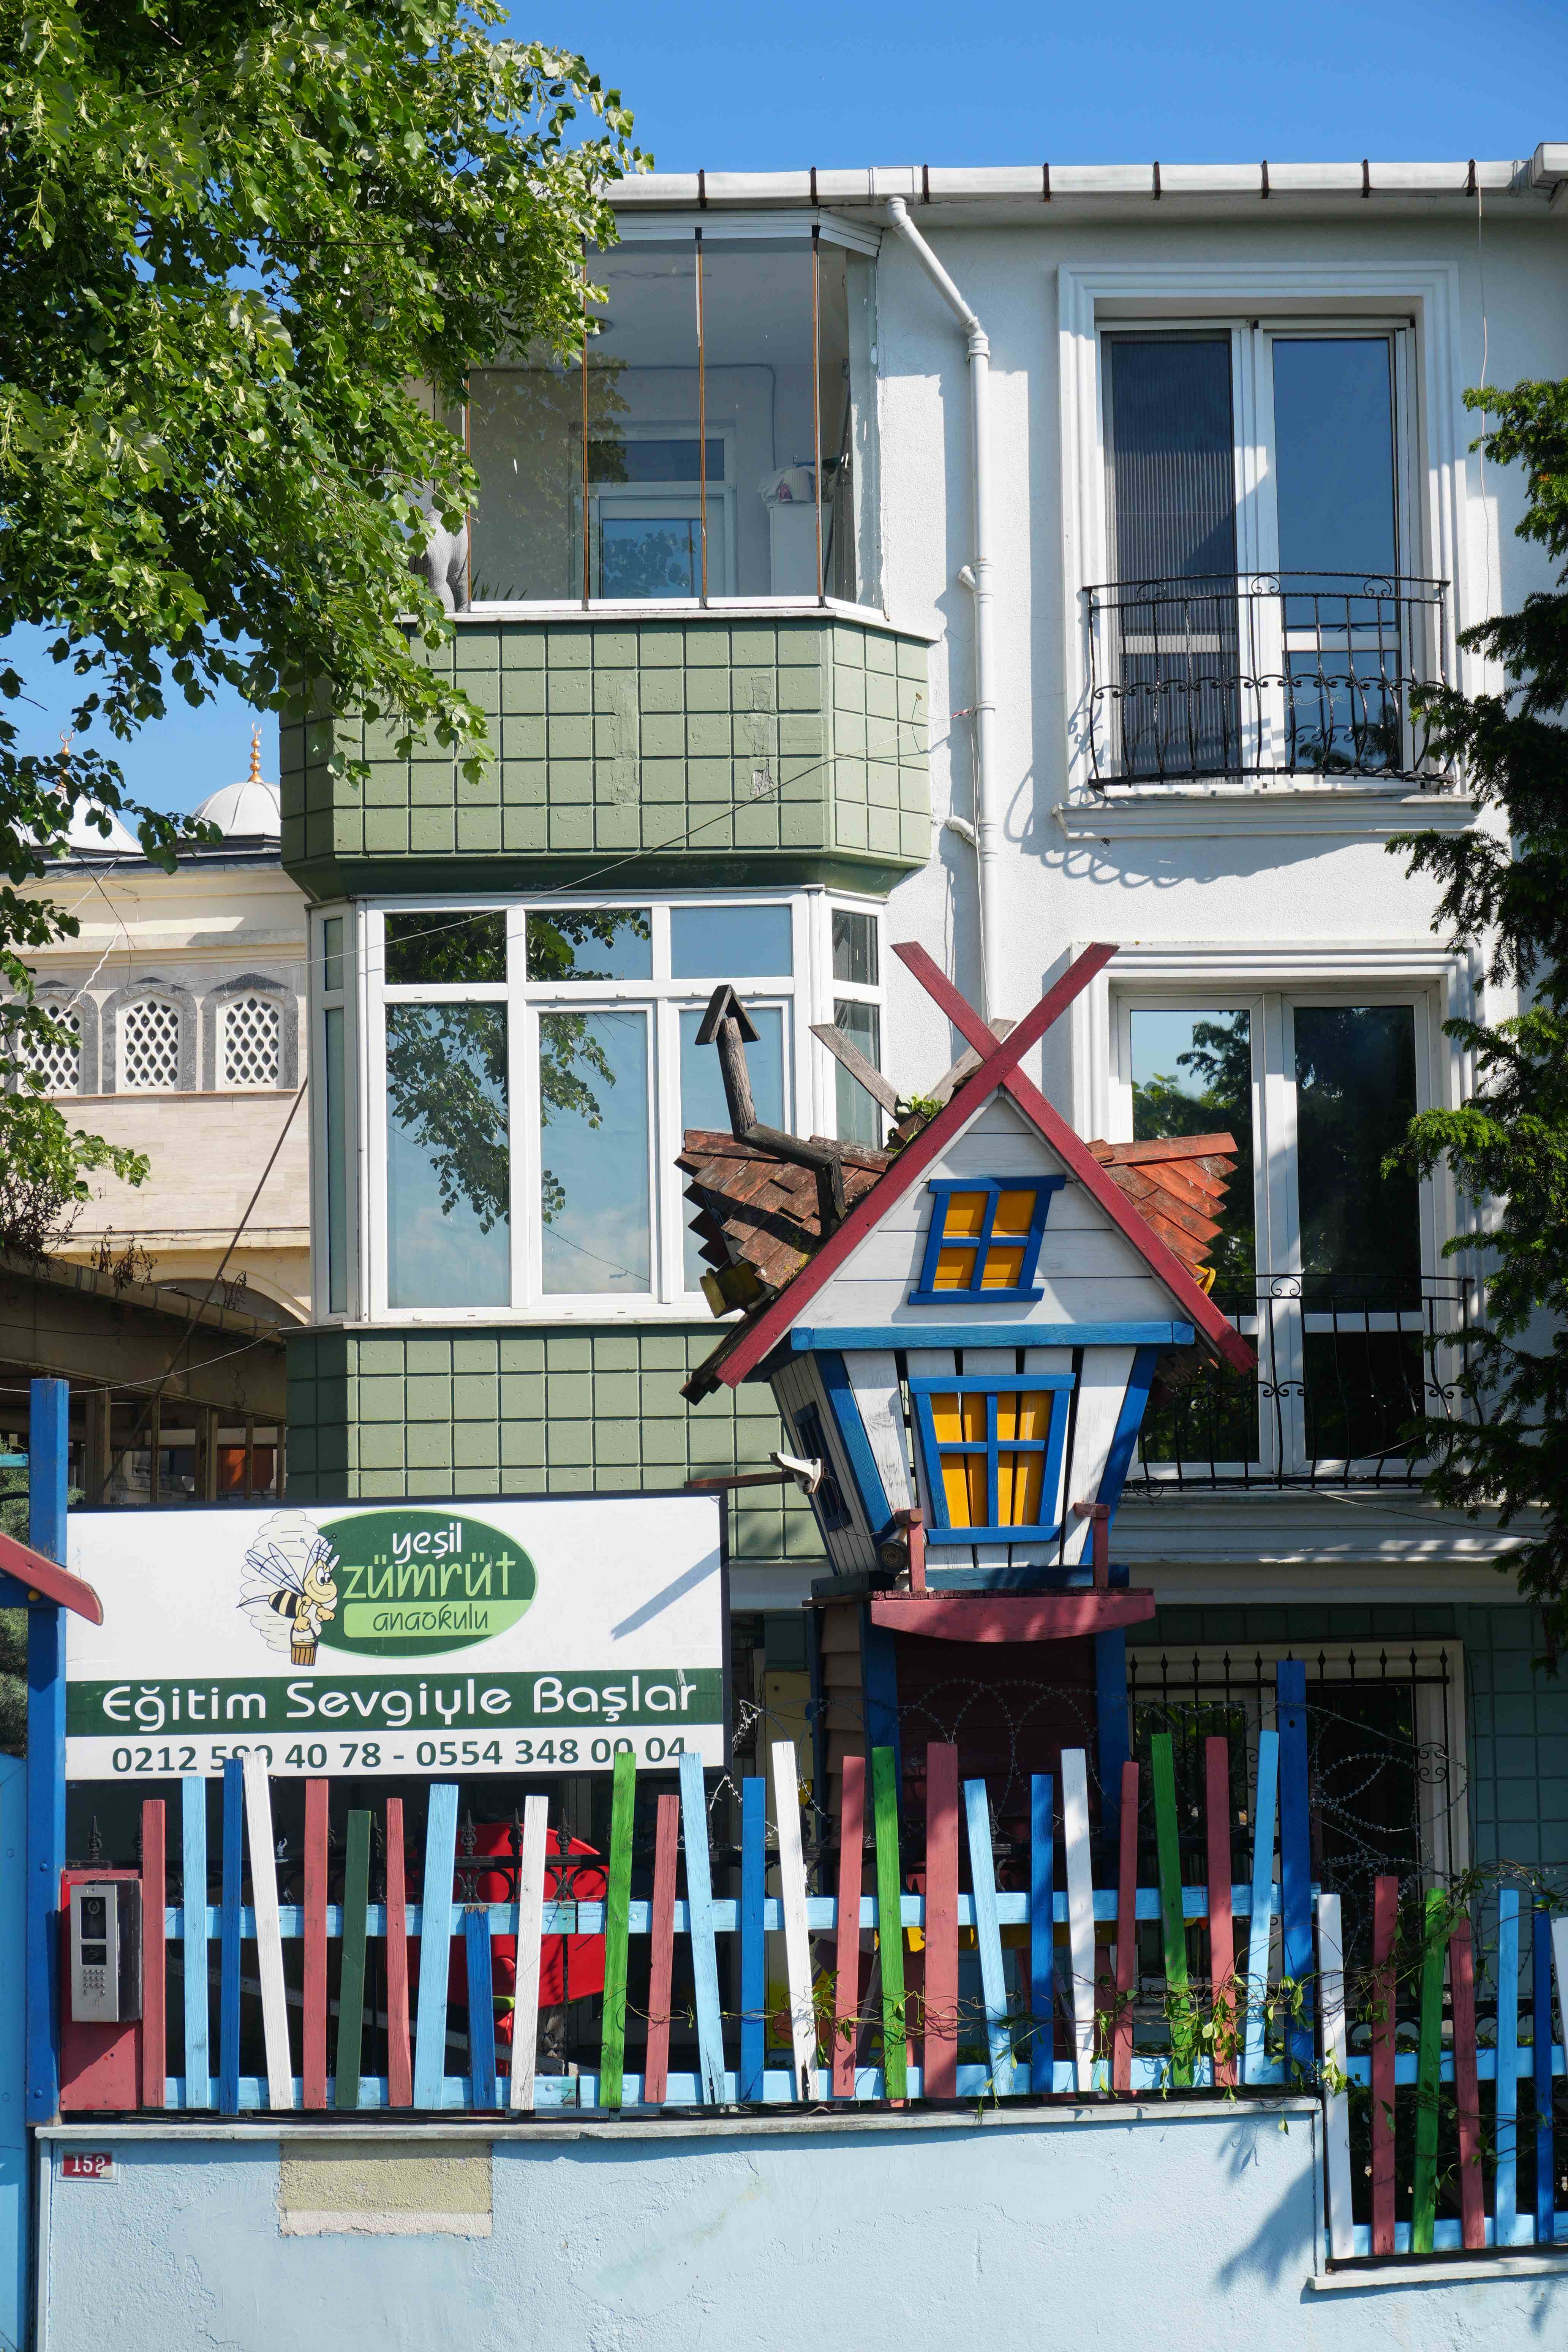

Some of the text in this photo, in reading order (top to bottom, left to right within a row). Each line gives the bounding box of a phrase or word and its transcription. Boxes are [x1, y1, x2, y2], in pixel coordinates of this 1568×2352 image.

[393, 1522, 461, 1564] yeşil
[373, 1603, 488, 1631] anaokulu
[103, 1675, 697, 1732] Eğitim Sevgiyle Başlar
[112, 1746, 197, 1772] 0212
[285, 1743, 327, 1769] 40
[340, 1743, 381, 1768] 78
[416, 1740, 503, 1766] 0554
[515, 1739, 579, 1765] 348
[645, 1737, 686, 1762] 04
[72, 2155, 105, 2174] 152
